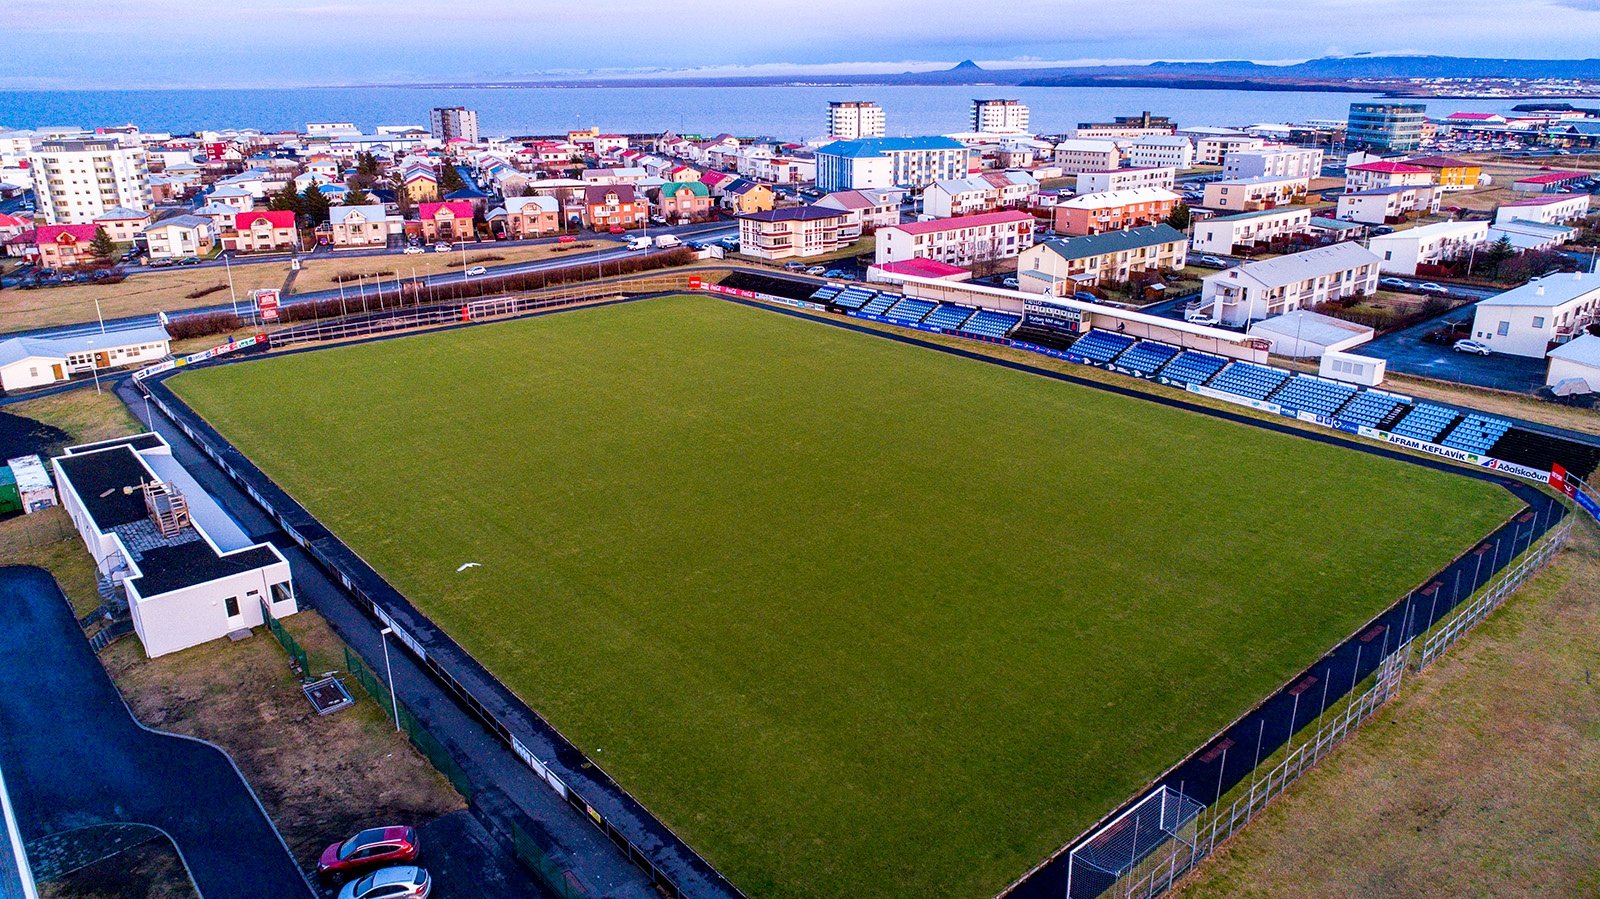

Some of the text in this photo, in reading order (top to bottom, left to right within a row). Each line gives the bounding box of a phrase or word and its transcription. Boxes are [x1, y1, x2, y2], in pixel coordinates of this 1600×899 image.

[1389, 435, 1465, 460] ÁFRAM KEFLAVÍK
[1497, 463, 1548, 481] Aðalskoðun
